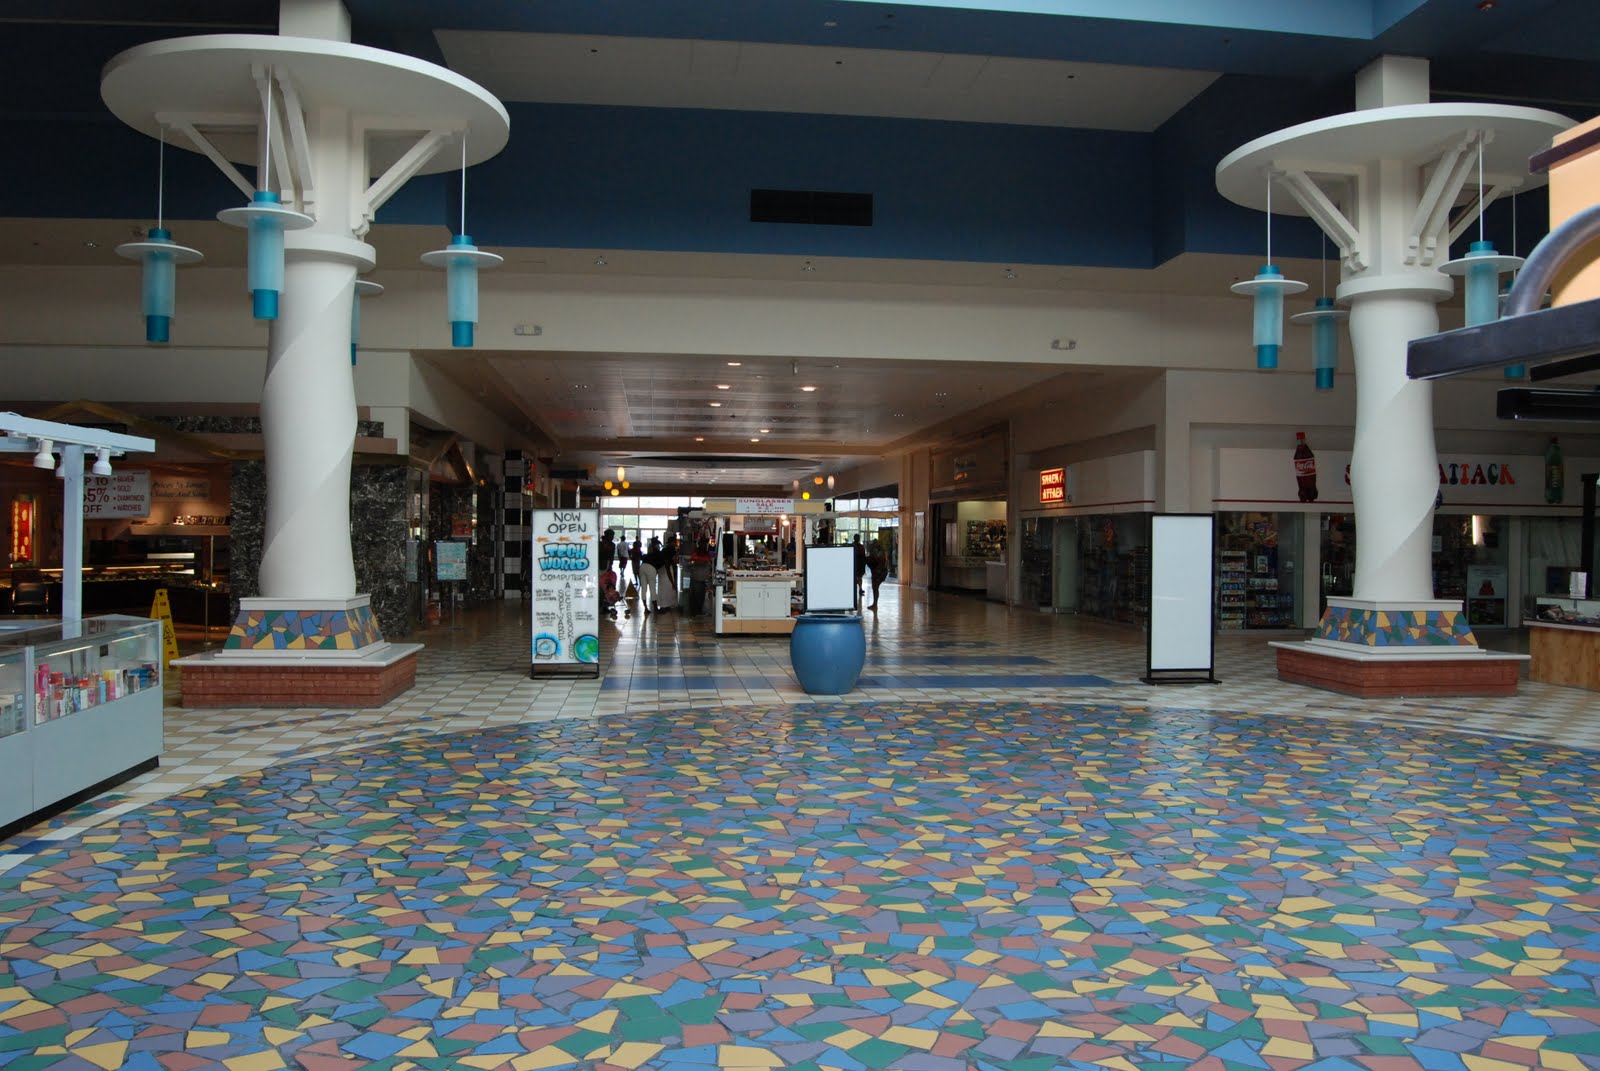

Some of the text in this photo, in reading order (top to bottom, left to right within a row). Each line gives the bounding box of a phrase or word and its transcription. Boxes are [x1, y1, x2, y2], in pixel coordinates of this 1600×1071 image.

[1439, 463, 1515, 486] ATTACK
[95, 477, 109, 486] TO
[1043, 487, 1064, 500] ATTACK
[83, 504, 104, 514] OFF
[117, 504, 142, 512] WATCHES
[554, 512, 582, 523] NOW
[548, 523, 587, 534] OPEN
[543, 543, 588, 559] TECH
[538, 556, 590, 571] WORLD
